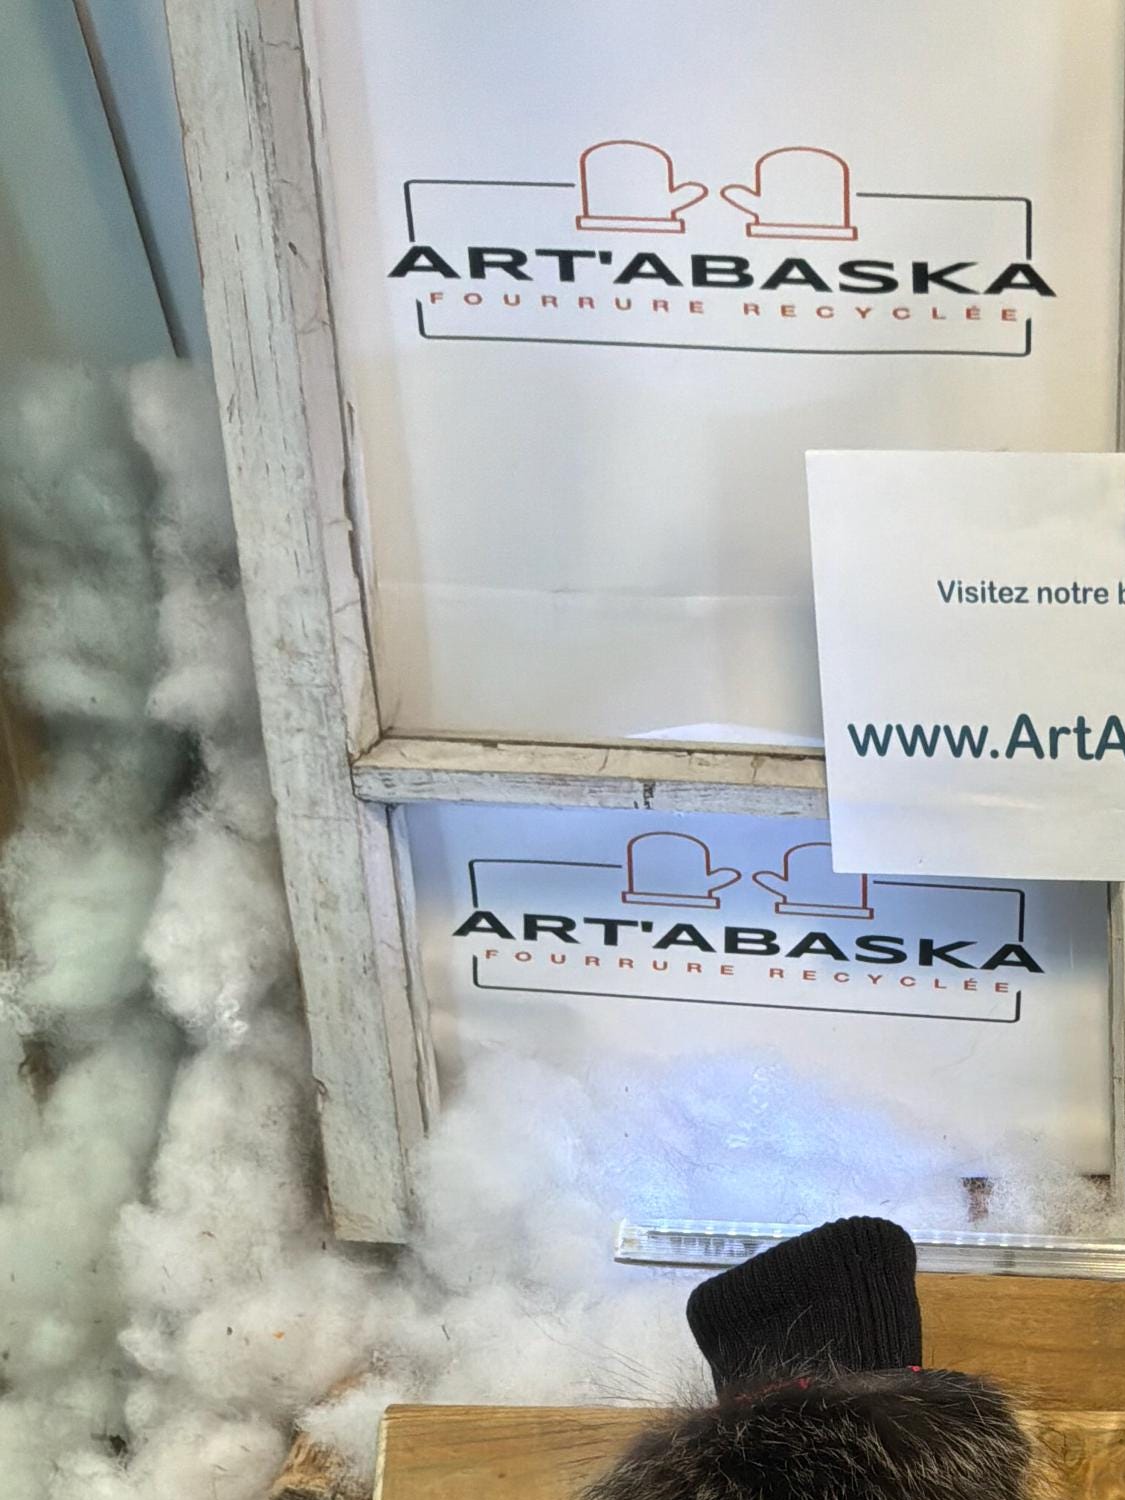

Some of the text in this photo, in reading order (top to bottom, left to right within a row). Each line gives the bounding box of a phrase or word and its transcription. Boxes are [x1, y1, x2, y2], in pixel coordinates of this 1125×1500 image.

[388, 245, 1057, 297] ART'ABASKA
[431, 292, 1018, 323] FOURRURE RECYCLÉE
[937, 579, 1029, 605] Visitez
[1037, 582, 1110, 606] notre
[452, 910, 1046, 974] ART'ABASKA
[485, 949, 1011, 993] FOURRURE RECYCLÉE
